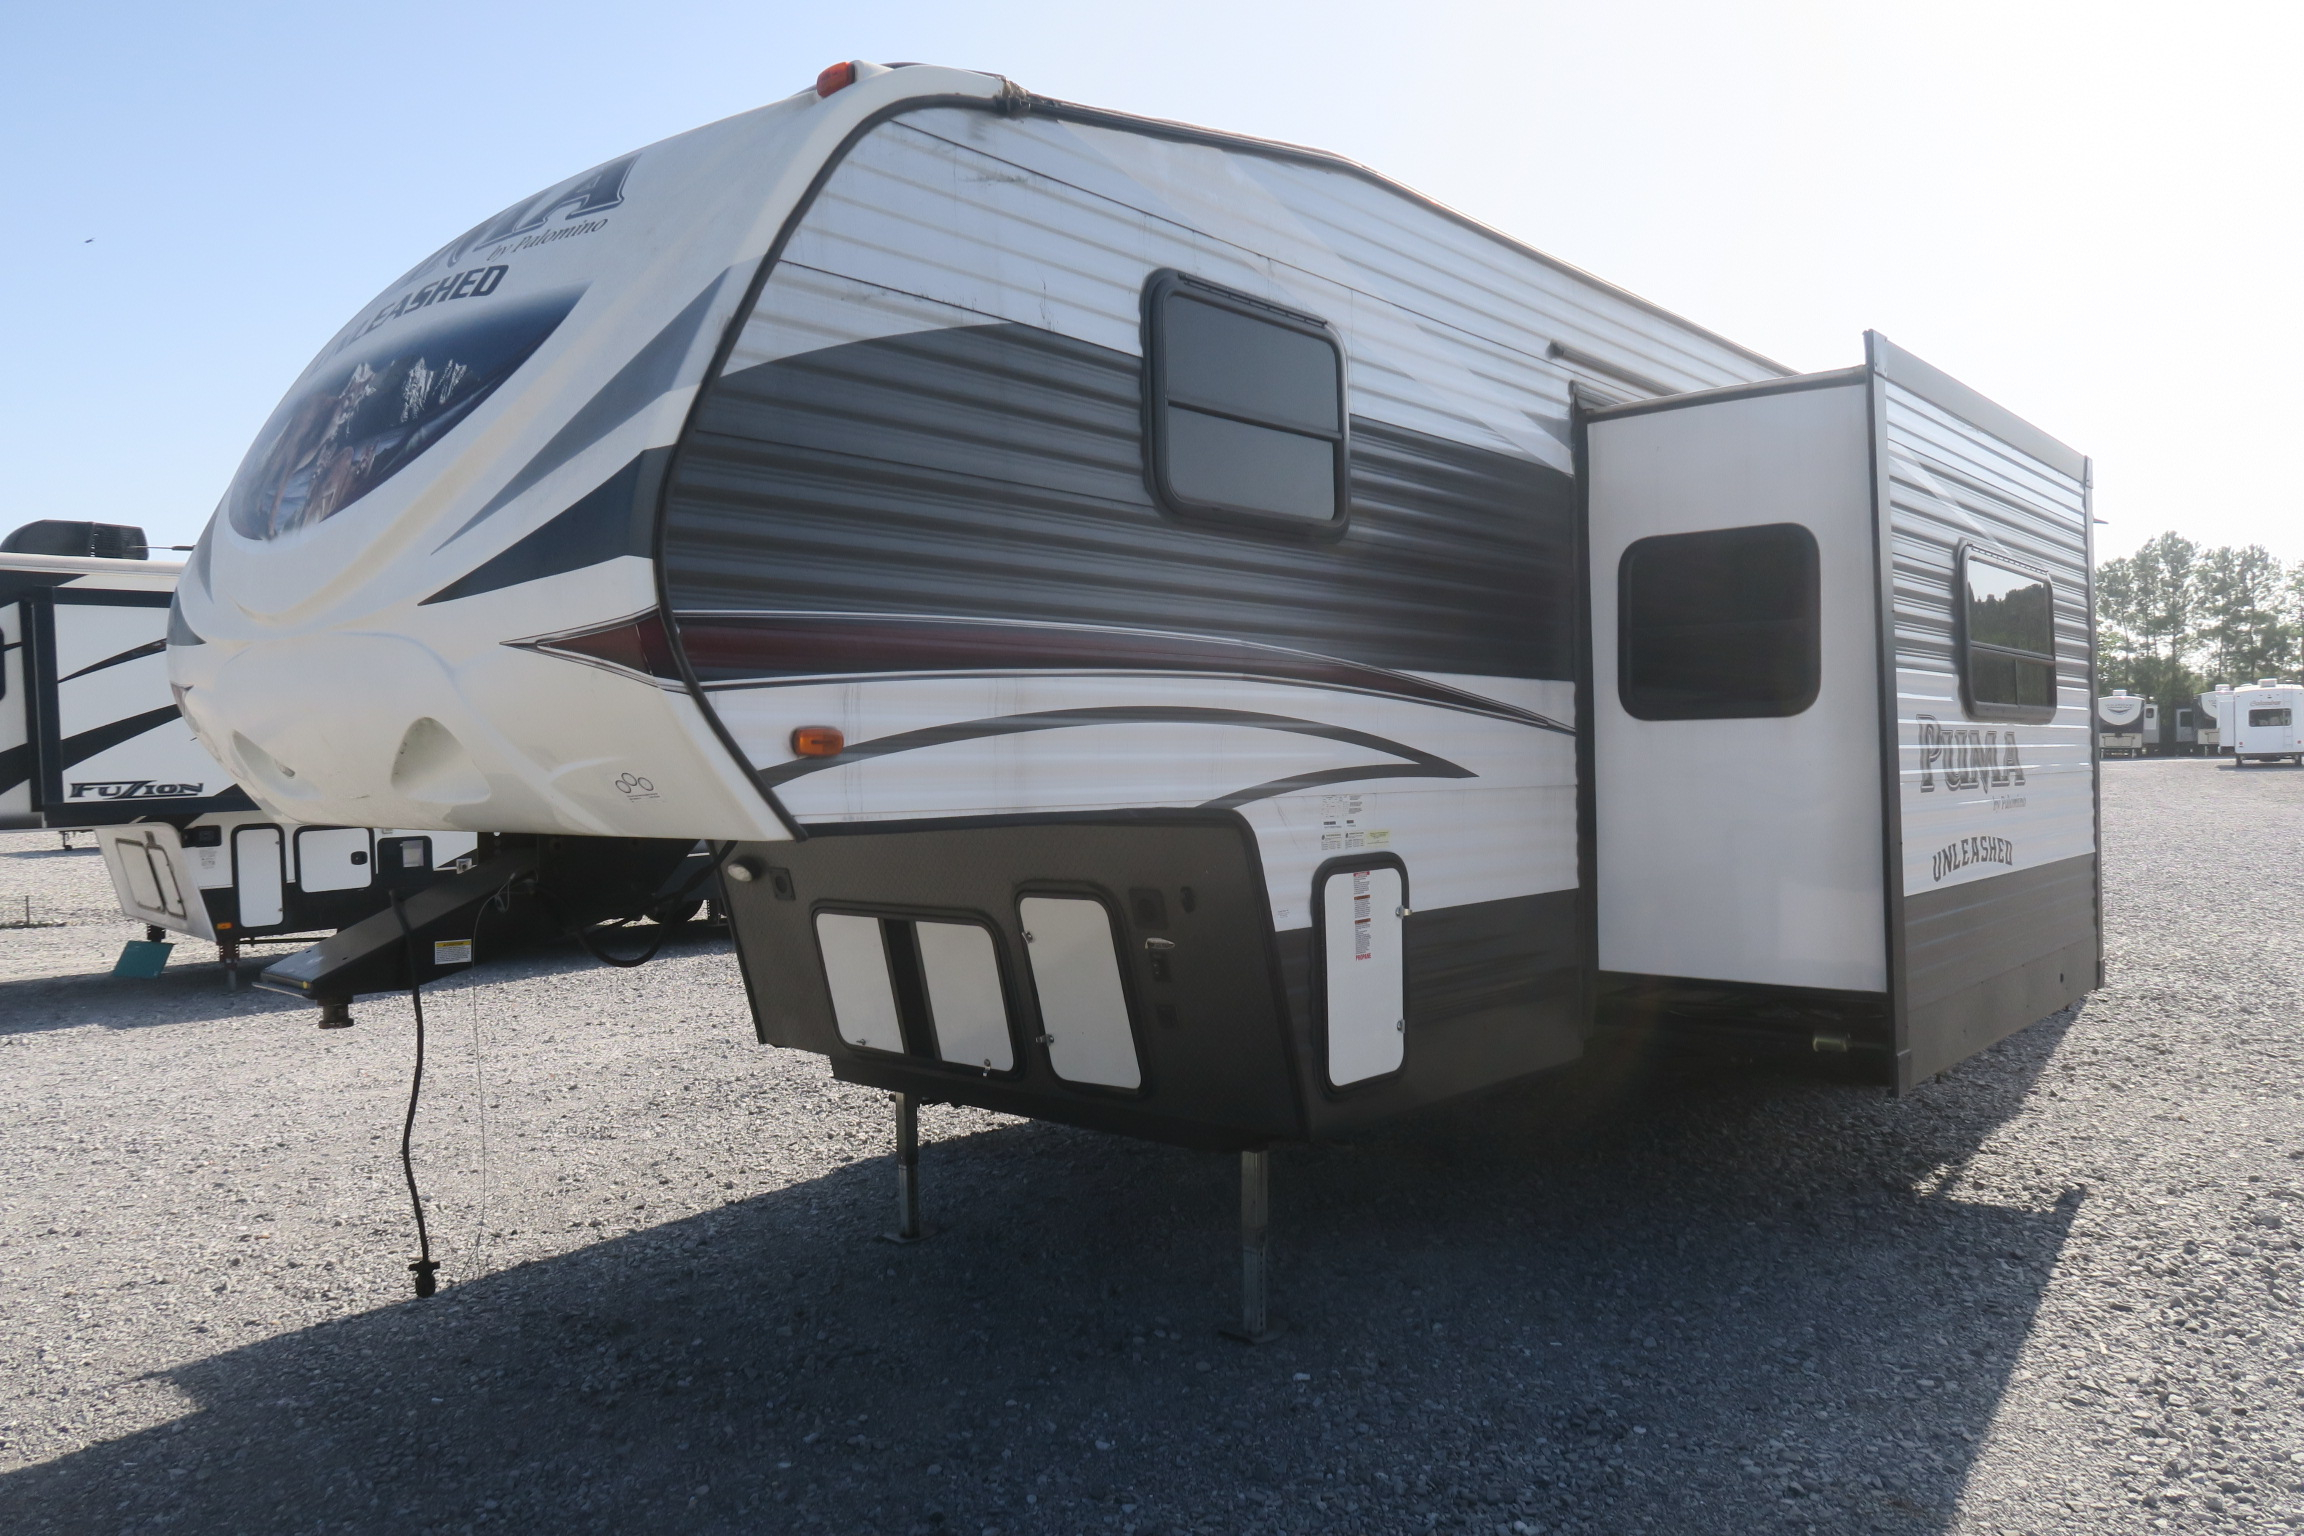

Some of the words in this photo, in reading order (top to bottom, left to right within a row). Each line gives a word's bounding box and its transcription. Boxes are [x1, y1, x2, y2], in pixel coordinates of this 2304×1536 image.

[486, 244, 514, 262] by
[512, 218, 609, 254] Palomino
[1916, 714, 2026, 794] PUMA
[69, 780, 204, 800] FUZION
[1932, 836, 2013, 882] UNLEASHED
[1356, 953, 1372, 962] PROPANE
